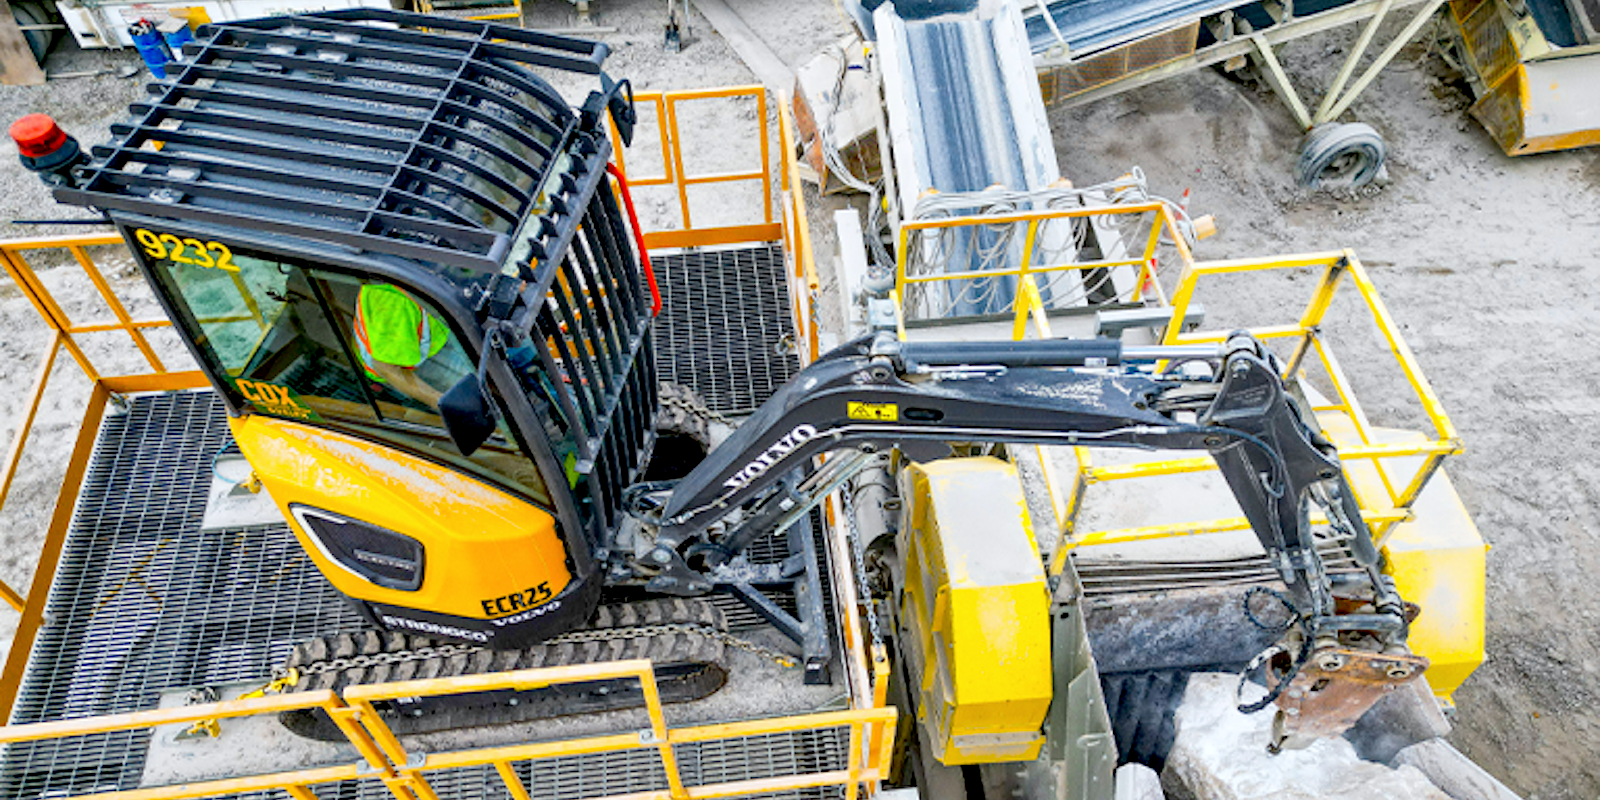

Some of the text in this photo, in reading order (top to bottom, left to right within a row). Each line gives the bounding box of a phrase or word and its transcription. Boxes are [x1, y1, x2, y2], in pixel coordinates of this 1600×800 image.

[135, 228, 240, 272] 9232
[235, 378, 299, 408] COX
[722, 424, 817, 489] VOLVO
[481, 581, 552, 617] ECR25
[490, 601, 562, 627] VOLVO
[382, 615, 489, 643] STRONGCO
